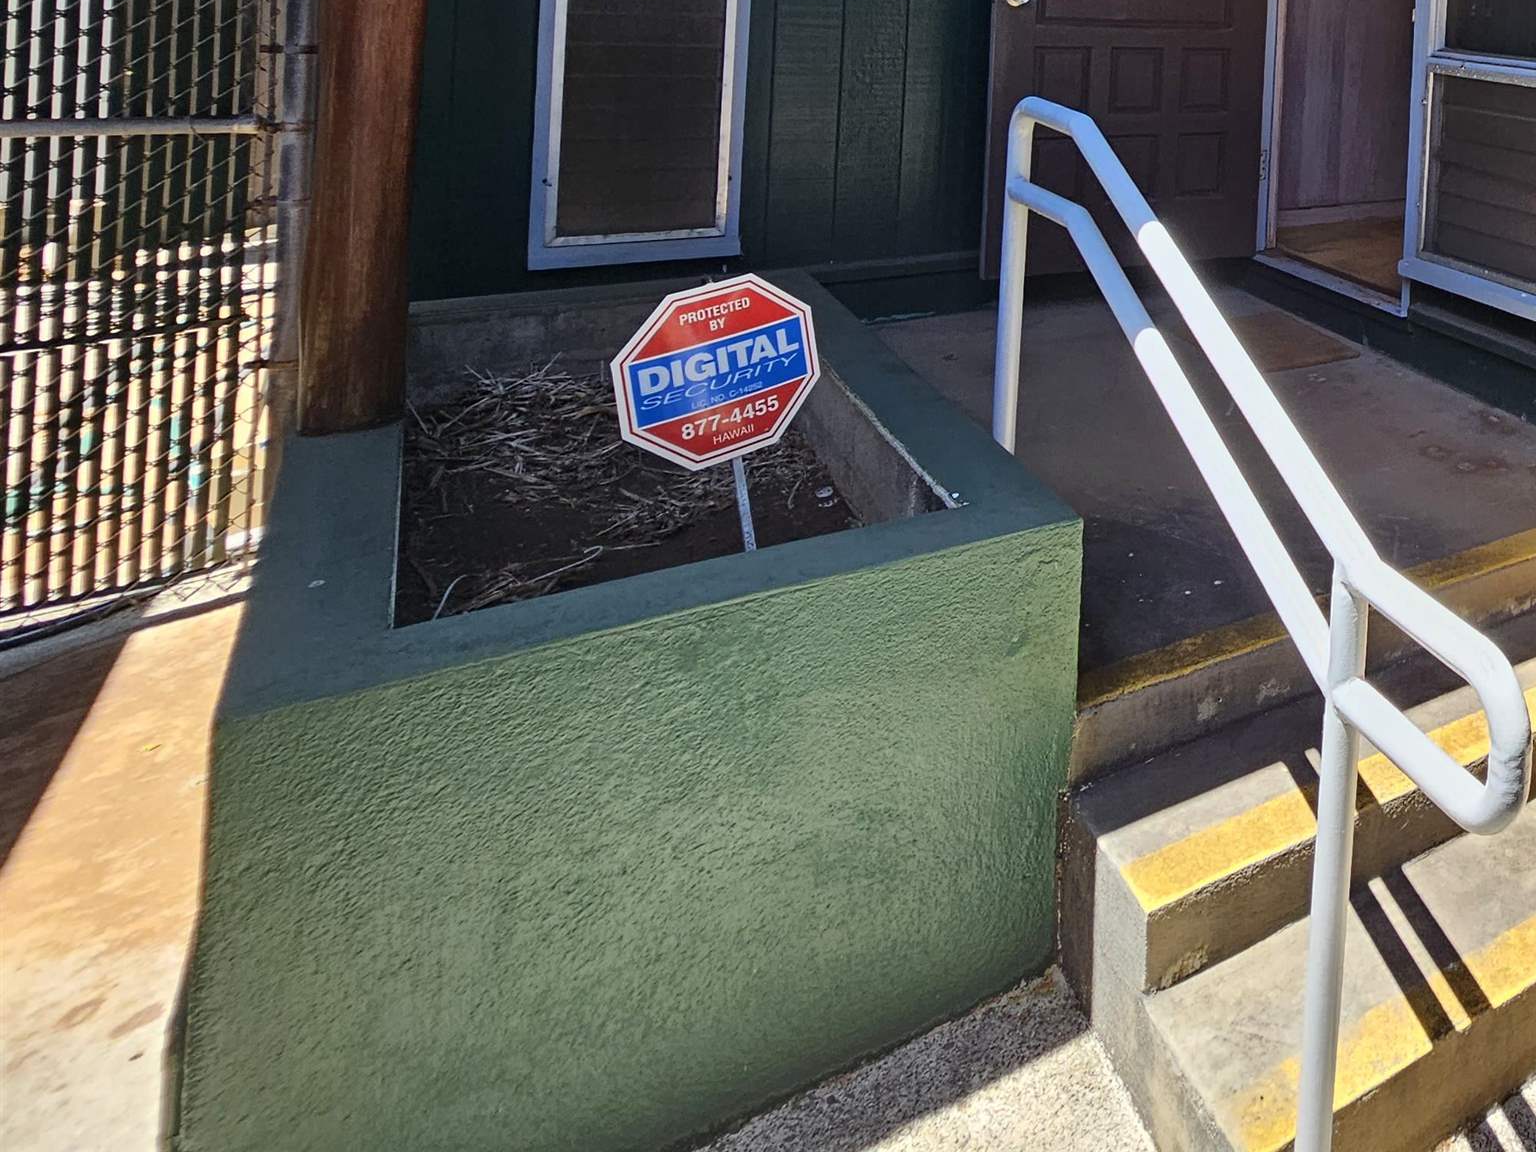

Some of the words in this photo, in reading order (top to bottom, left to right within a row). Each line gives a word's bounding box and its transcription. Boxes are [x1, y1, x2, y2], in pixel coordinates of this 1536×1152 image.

[679, 297, 750, 326] PROTECTED
[709, 318, 726, 332] BY
[637, 328, 800, 396] DIGITAL
[640, 352, 798, 411] SECURITY
[681, 395, 780, 441] 877-4455
[712, 424, 755, 446] HAWAII
